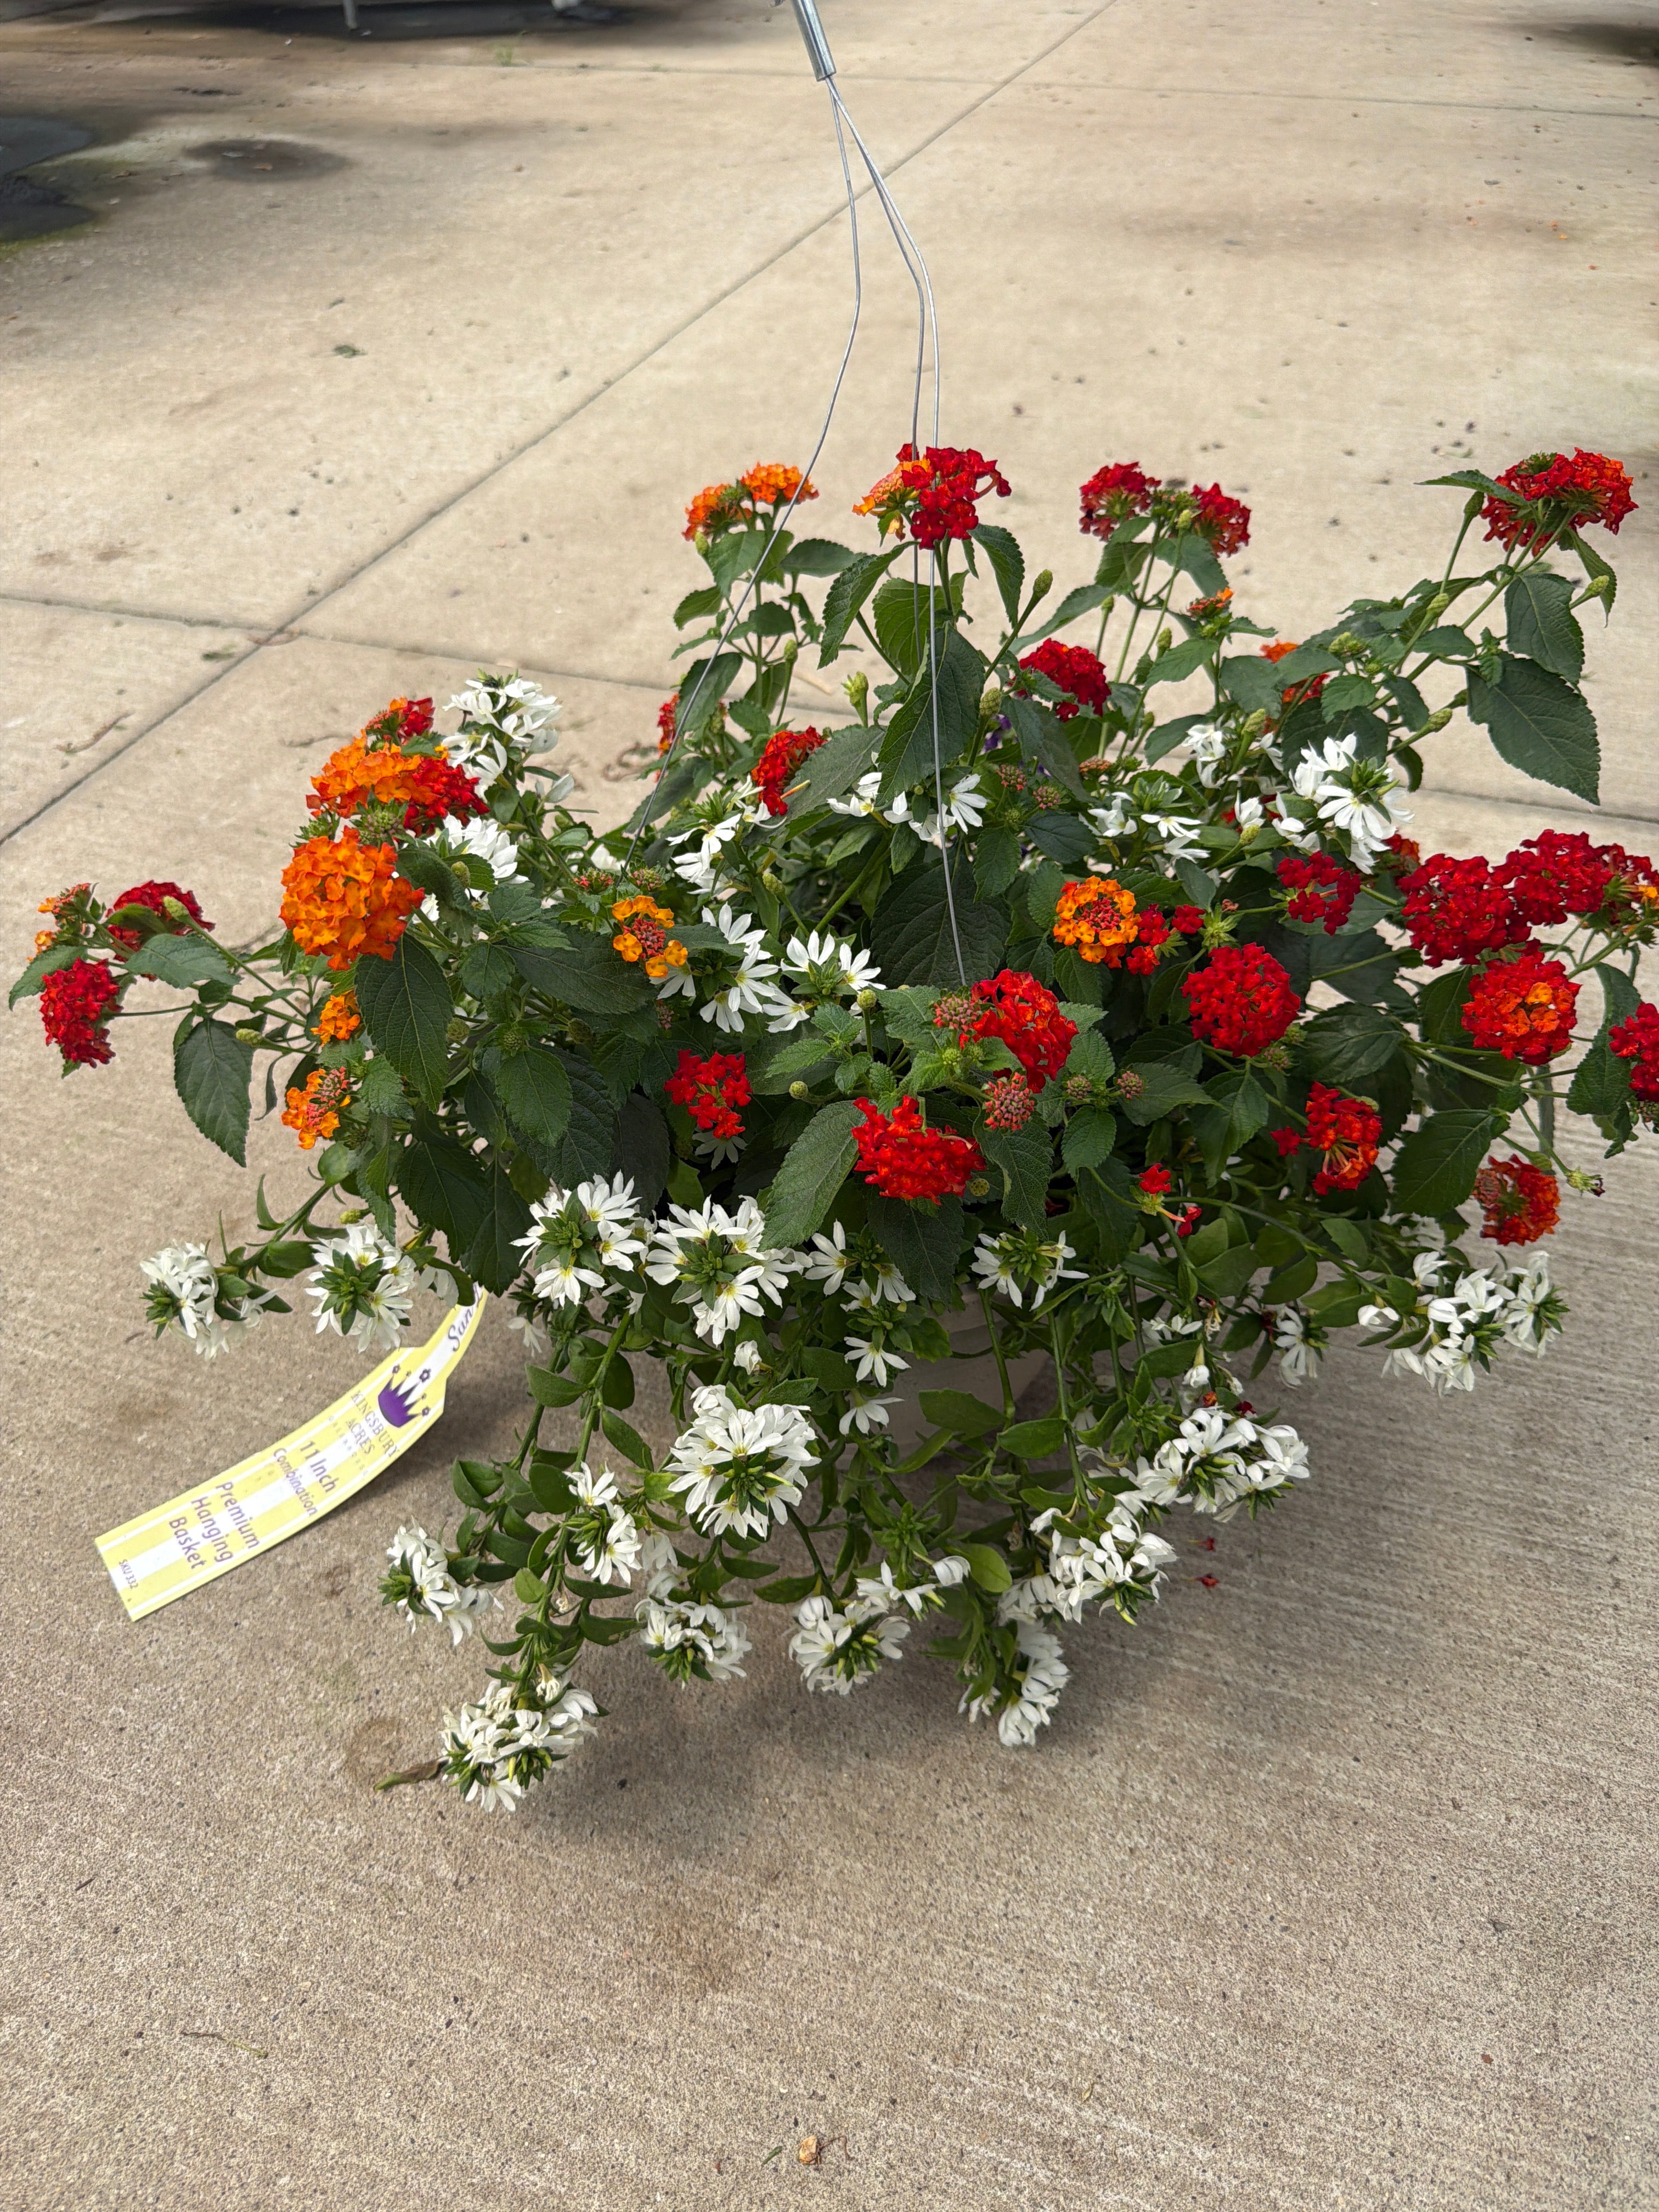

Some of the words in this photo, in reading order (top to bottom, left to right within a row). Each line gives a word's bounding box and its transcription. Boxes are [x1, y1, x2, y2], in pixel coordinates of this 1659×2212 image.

[345, 1417, 375, 1454] ACRES
[351, 1390, 400, 1457] KINGSBURY
[273, 1448, 318, 1516] Combination
[300, 1441, 320, 1460] 11
[310, 1458, 339, 1492] Inch
[168, 1516, 206, 1569] Basket
[191, 1496, 233, 1562] Hanging
[216, 1482, 259, 1549] Premium
[119, 1559, 133, 1574] SKU
